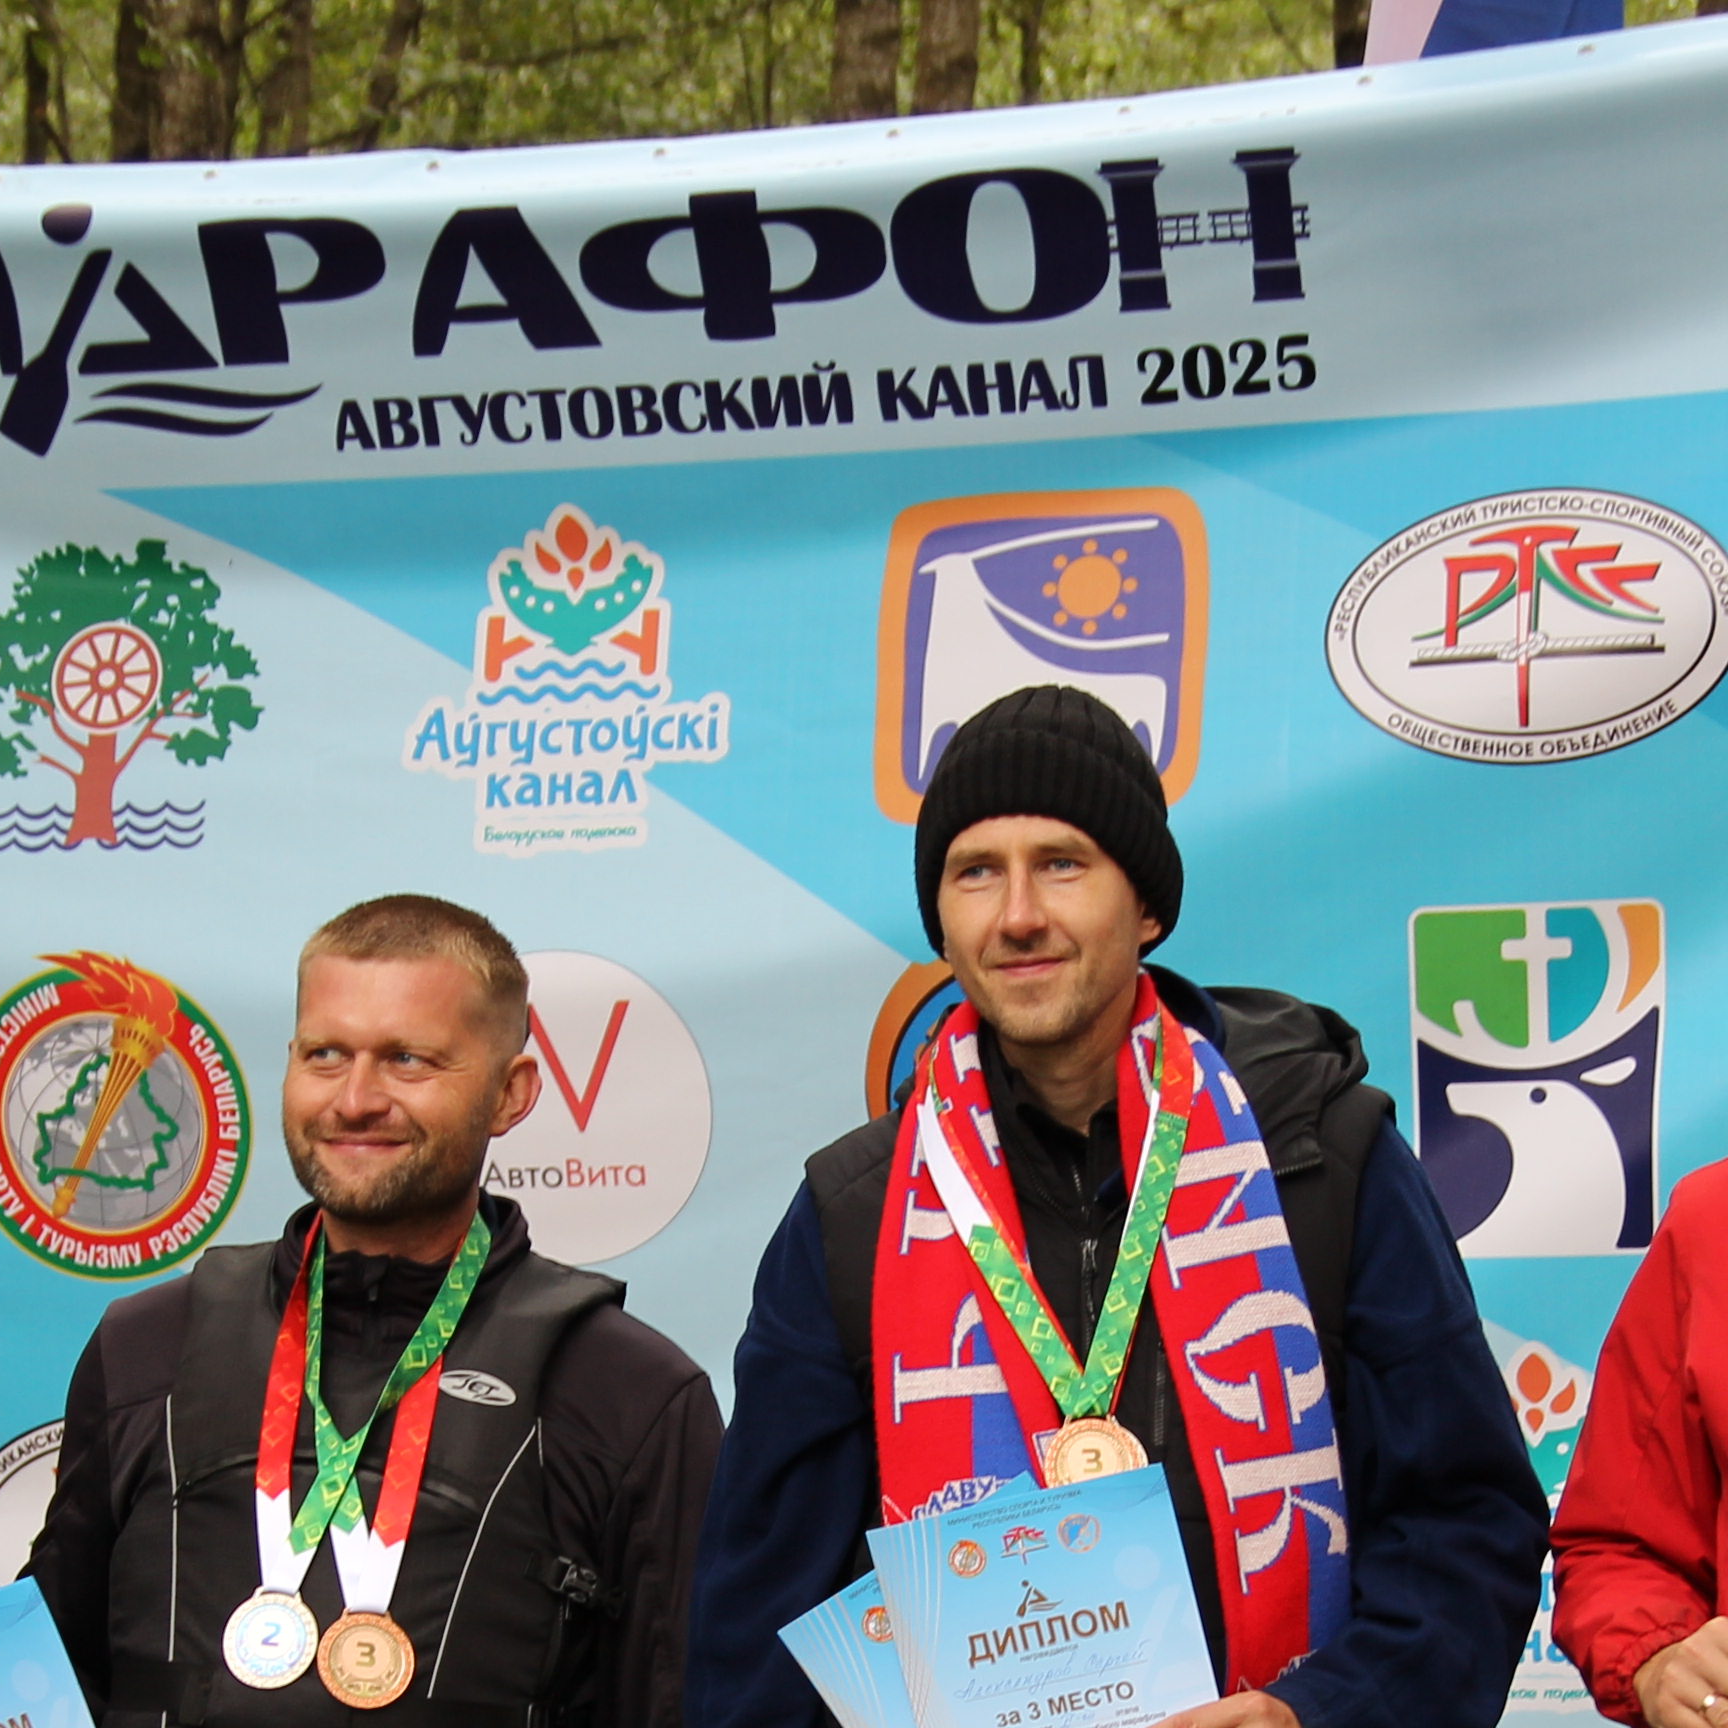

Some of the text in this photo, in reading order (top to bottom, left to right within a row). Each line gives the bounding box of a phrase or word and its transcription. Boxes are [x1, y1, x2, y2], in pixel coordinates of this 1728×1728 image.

[334, 336, 1318, 452] АВГУСТОВСКИЙ КАНАЛ 2025
[1479, 494, 1703, 553] ТУРИСТСКО-СПОРТИВНЫЙ
[1387, 698, 1678, 758] ОБЩЕСТВЕННОЕ ОБЪЕДИНЕНИЕ
[485, 769, 638, 809] канал
[35, 1222, 143, 1270] ТУРЫЗМУ
[188, 1021, 241, 1141] БЕЛАРУСЬ
[482, 1157, 647, 1190] АвтоВита
[1081, 1447, 1104, 1474] 3
[261, 1621, 281, 1647] 2
[355, 1641, 376, 1668] 3
[968, 1601, 1131, 1670] ДИПЛОМ
[995, 1680, 1135, 1728] за 3 МЕСТО
